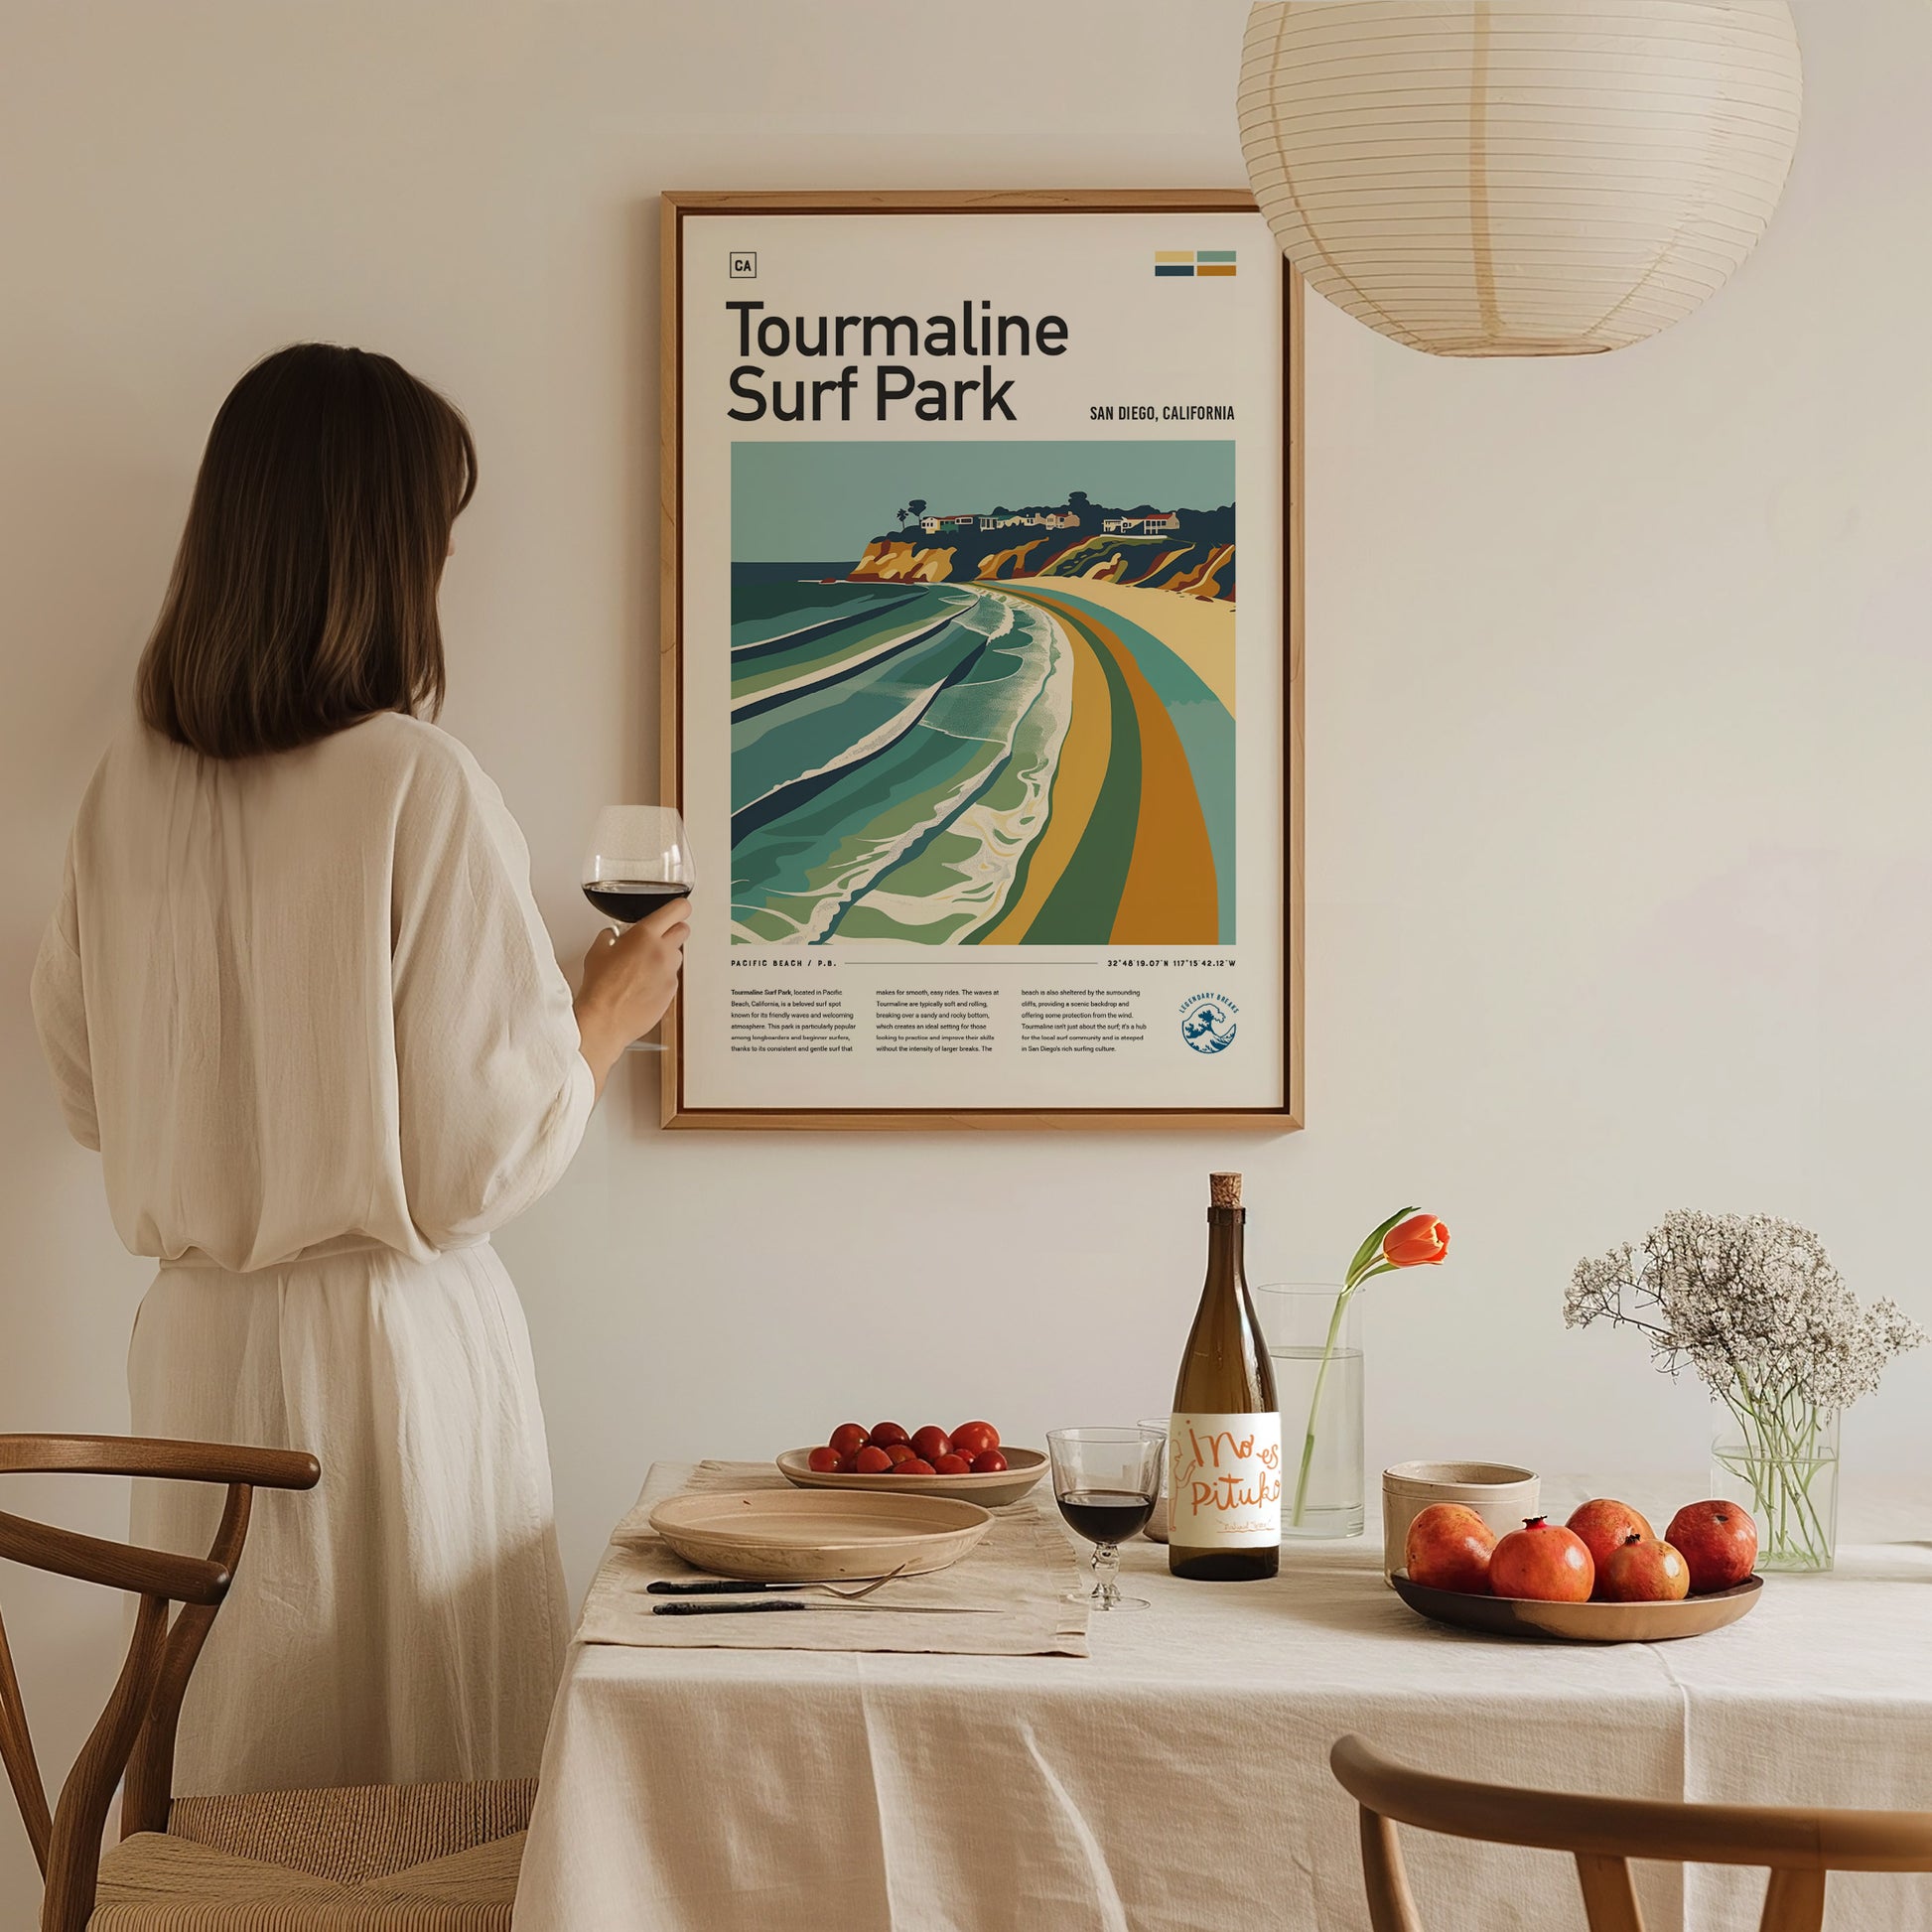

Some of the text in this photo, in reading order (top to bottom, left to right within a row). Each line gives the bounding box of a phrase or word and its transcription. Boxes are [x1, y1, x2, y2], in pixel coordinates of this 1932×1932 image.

[734, 259, 752, 272] CA
[725, 300, 1068, 357] Tourmaline
[727, 364, 1018, 422] Surf Park
[1089, 405, 1235, 423] SAN DIEGO, CALIFORNIA
[1087, 989, 1095, 997] by
[1105, 989, 1141, 998] surrounding
[828, 1000, 842, 1009] spot
[919, 1000, 944, 1009] typically
[1038, 1000, 1065, 1009] providing
[1090, 1000, 1118, 1009] backdrop
[1178, 993, 1240, 1014] LEGENDARY BREAKS
[768, 1011, 791, 1020] friendly
[822, 1011, 854, 1020] welcoming
[876, 1011, 901, 1020] breaking
[920, 1011, 938, 1020] sandy
[950, 1011, 967, 1021] rocky
[1021, 1011, 1044, 1020] offering
[1062, 1011, 1092, 1020] protection
[781, 1023, 795, 1031] park
[801, 1023, 834, 1031] particularly
[833, 1023, 856, 1031] popular
[940, 1023, 960, 1031] setting
[1066, 1023, 1079, 1032] just
[809, 1045, 828, 1053] gentle
[909, 1045, 934, 1054] intensity
[941, 1045, 959, 1053] larger
[1073, 1045, 1095, 1053] surfing
[1256, 1444, 1279, 1469] es
